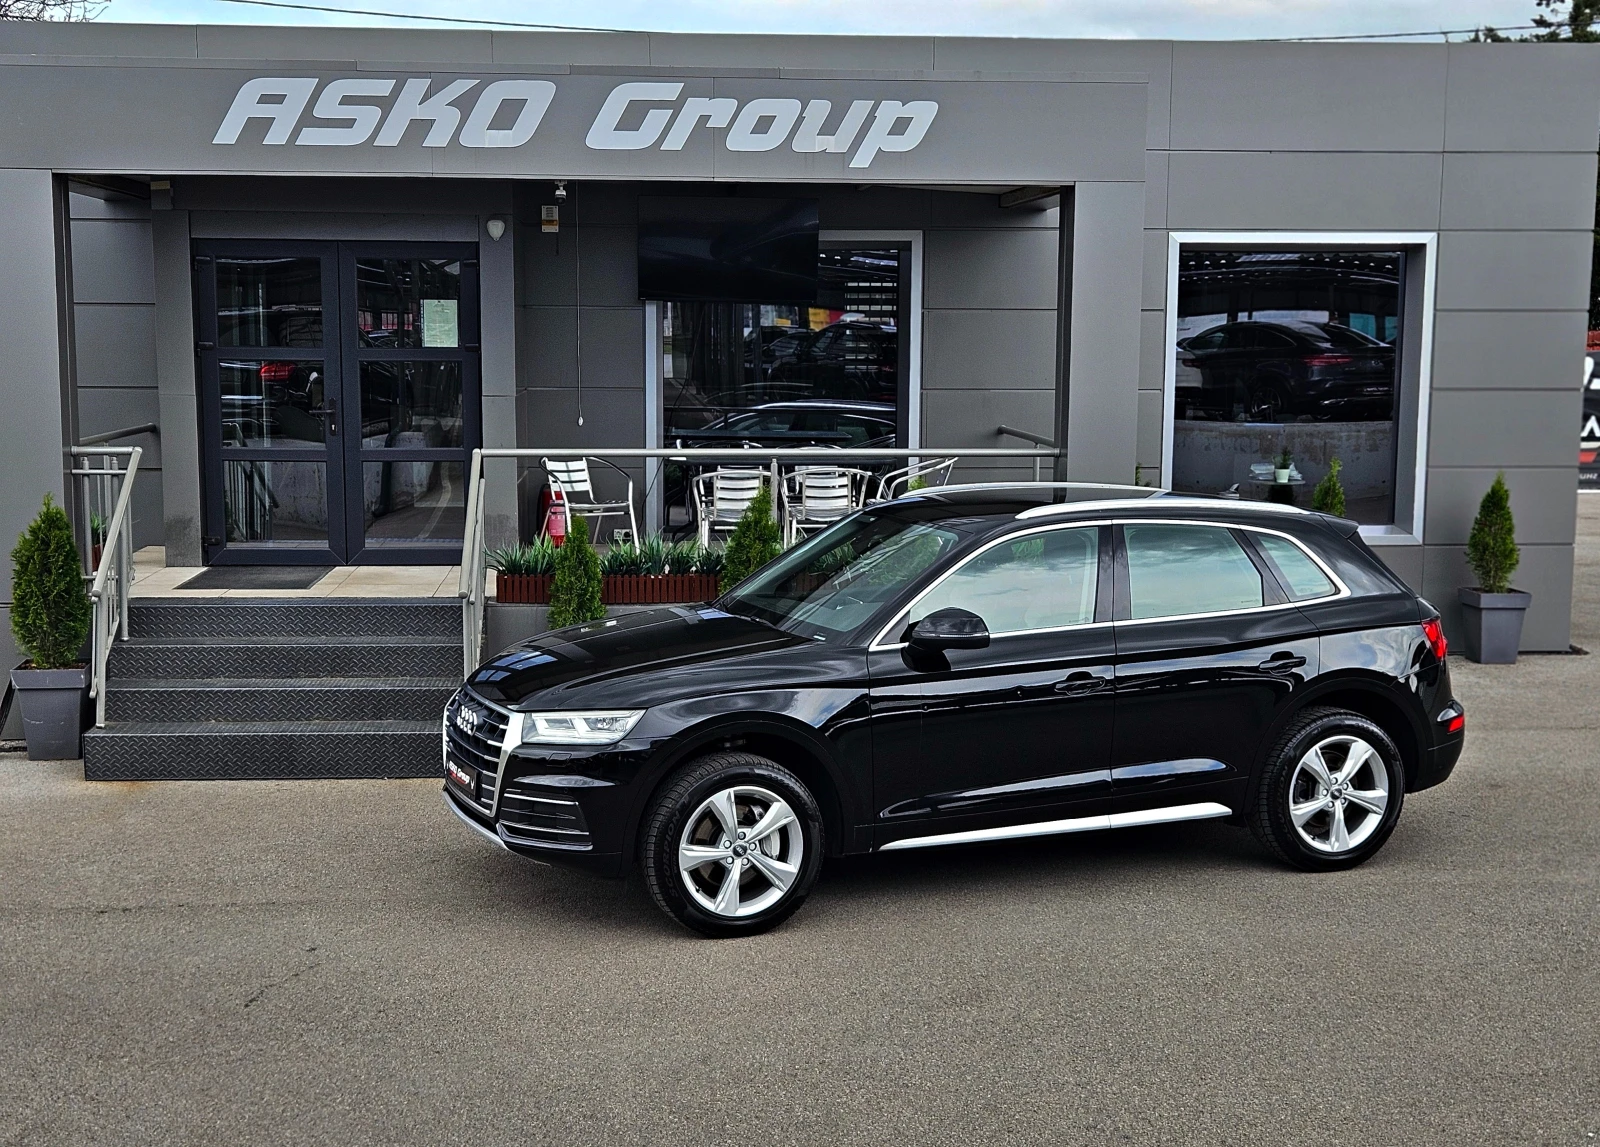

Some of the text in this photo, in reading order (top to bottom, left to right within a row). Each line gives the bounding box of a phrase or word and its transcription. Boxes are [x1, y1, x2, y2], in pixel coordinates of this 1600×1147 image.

[212, 77, 939, 169] ASKO Group
[662, 810, 681, 898] SCORPION
